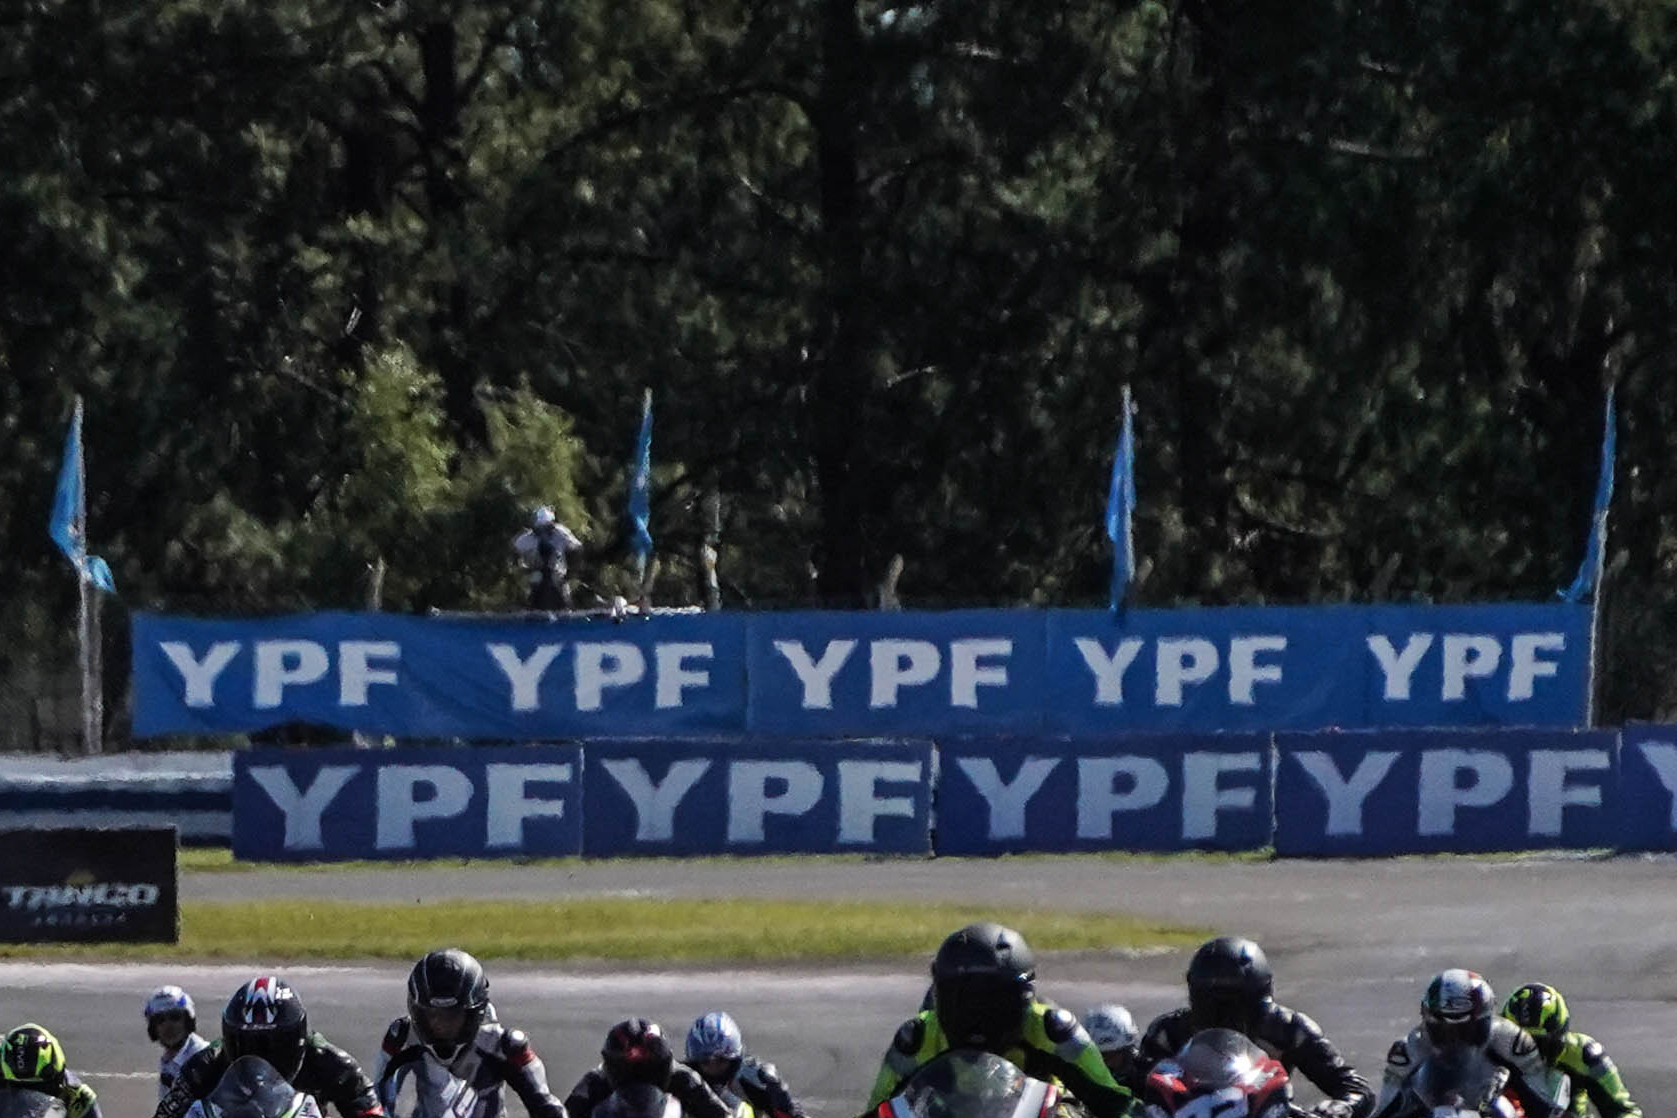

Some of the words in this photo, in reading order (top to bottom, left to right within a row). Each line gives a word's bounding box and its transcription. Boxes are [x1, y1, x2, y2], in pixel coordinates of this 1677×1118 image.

[159, 640, 401, 708] YPF
[487, 641, 714, 711] YPF
[773, 639, 1013, 709] YPF
[1074, 635, 1287, 705] YPF
[1365, 633, 1565, 701] YPF
[249, 764, 571, 848] YPF
[602, 759, 924, 843] YPF
[957, 752, 1262, 840] YPF
[1292, 749, 1610, 837] YPF
